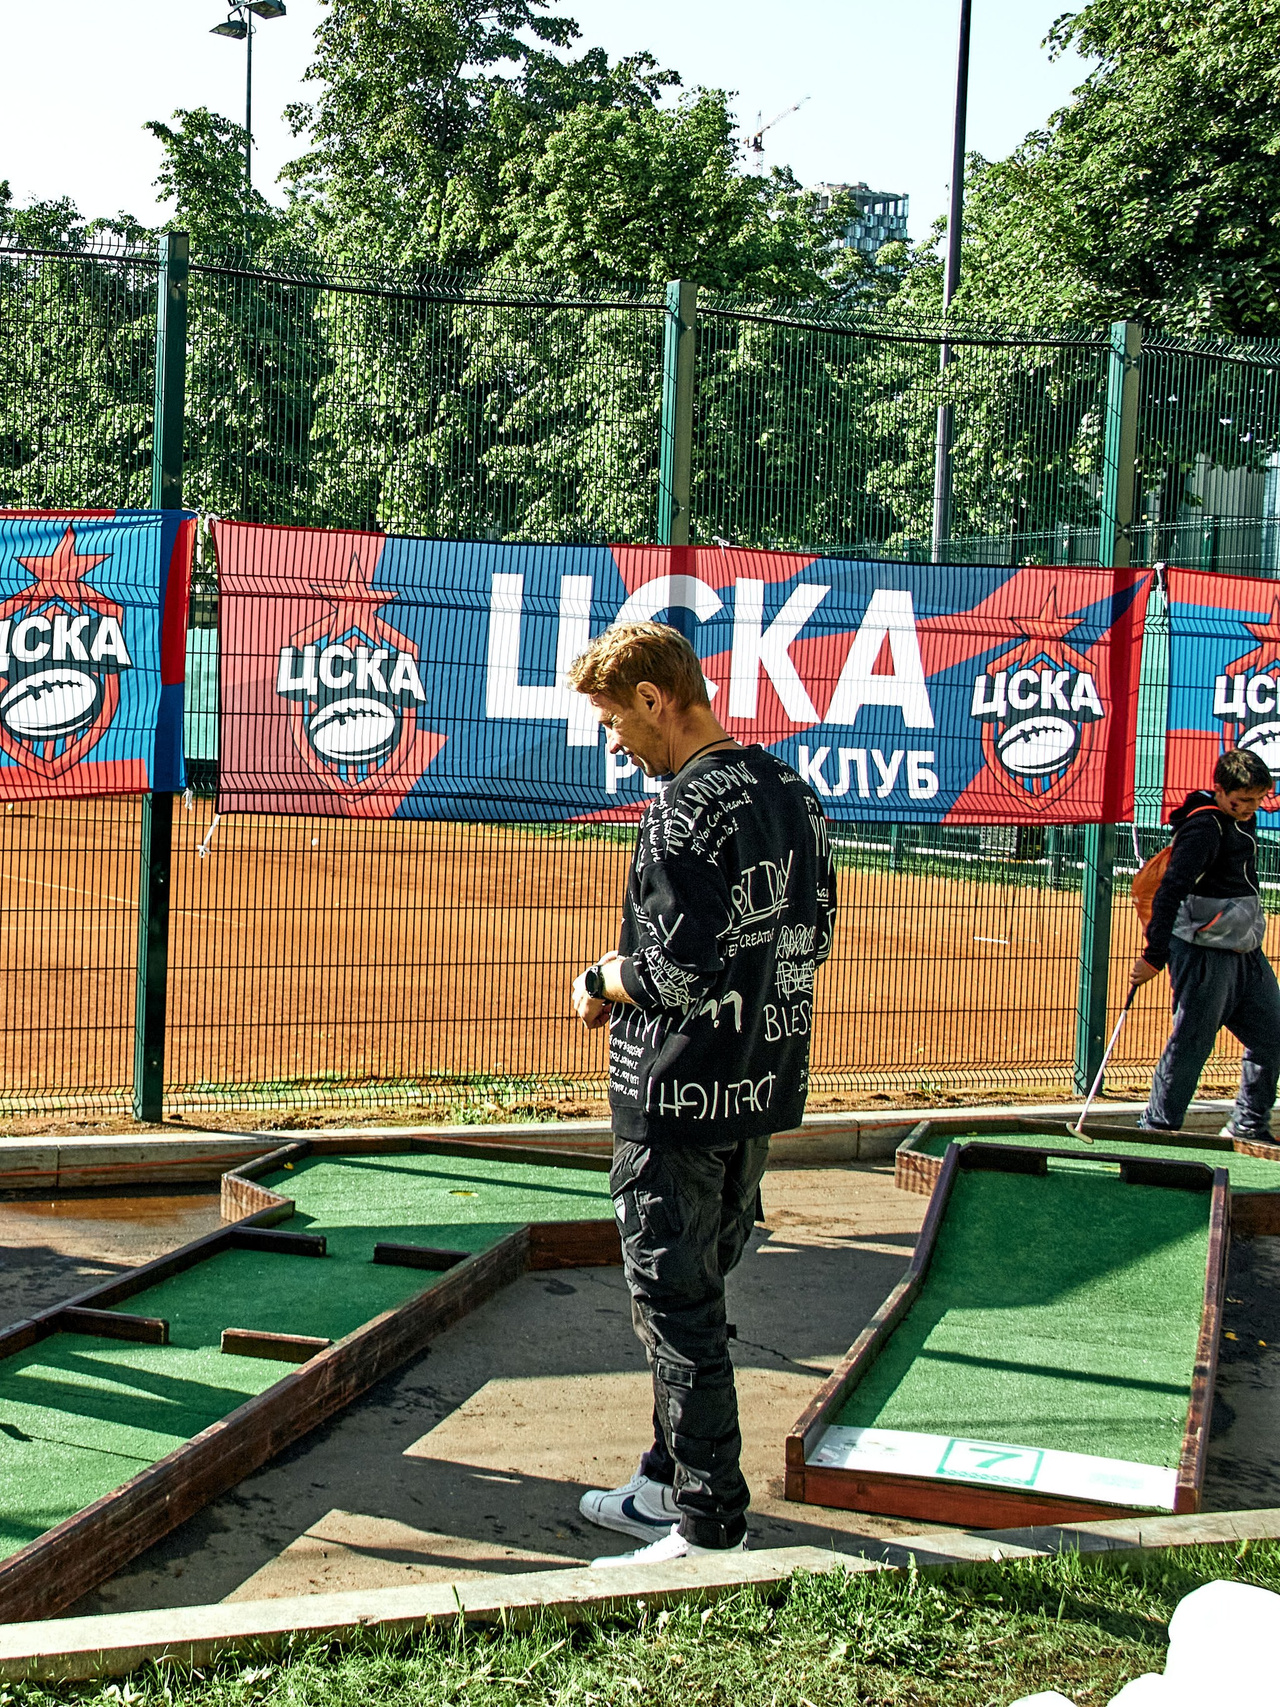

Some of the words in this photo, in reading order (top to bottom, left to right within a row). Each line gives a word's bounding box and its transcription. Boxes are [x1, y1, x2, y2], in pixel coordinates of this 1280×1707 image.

[277, 644, 426, 702] ЦСКА
[971, 670, 1105, 720] ЦСКА
[1213, 673, 1280, 718] ЦС
[968, 1447, 1023, 1469] 7
